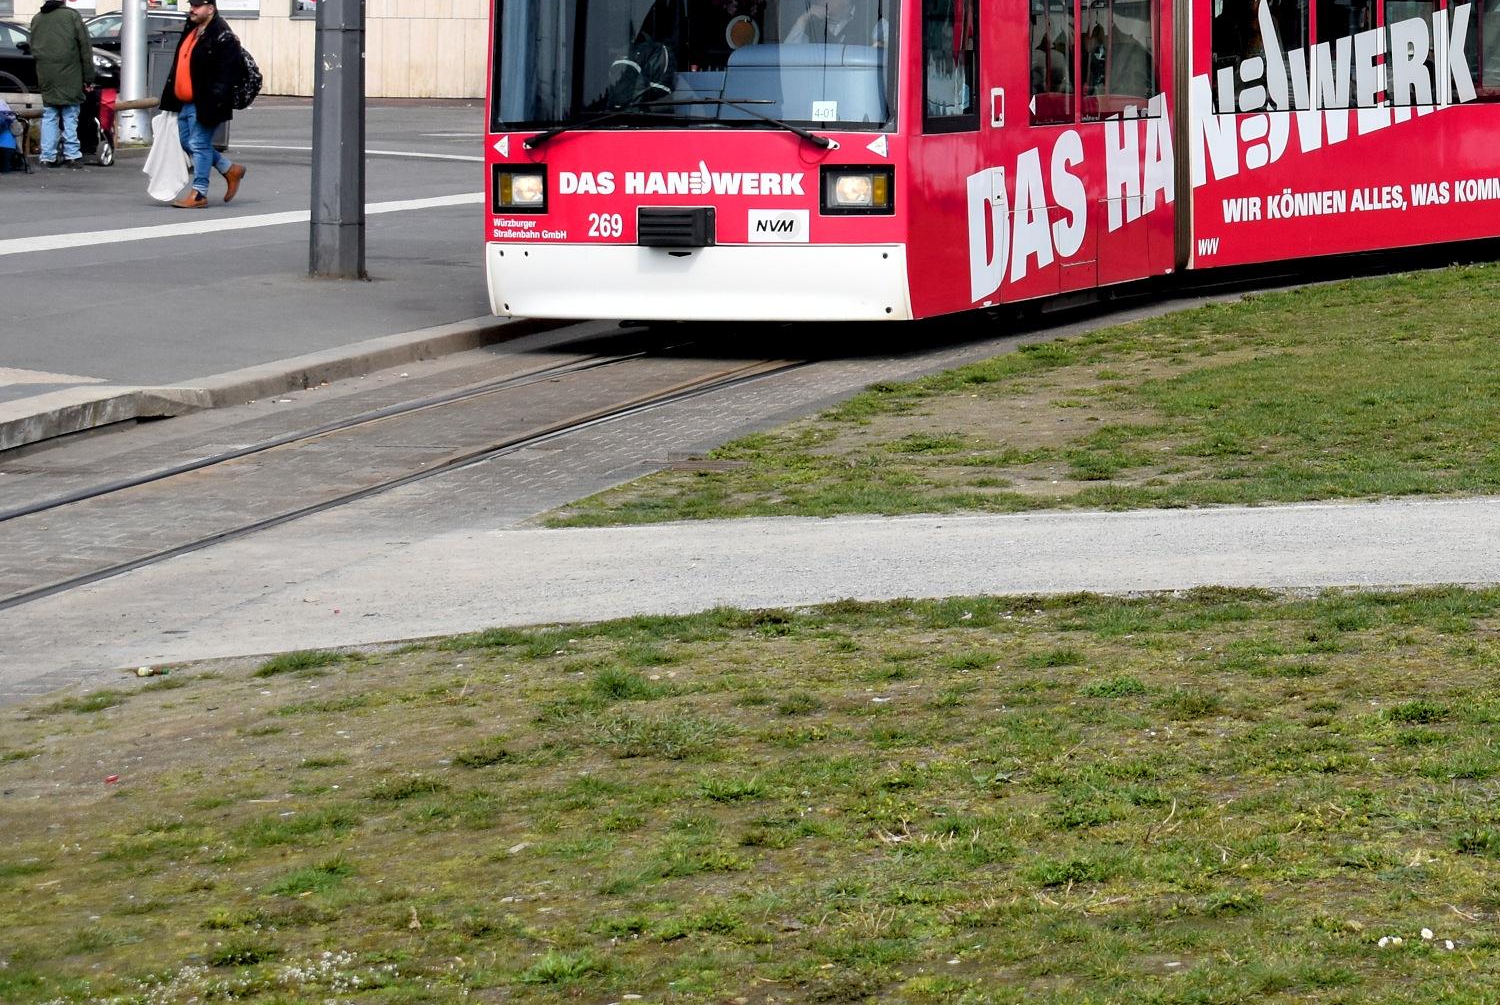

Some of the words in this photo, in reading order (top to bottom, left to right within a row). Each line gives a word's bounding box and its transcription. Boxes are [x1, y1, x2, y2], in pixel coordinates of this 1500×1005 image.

[559, 171, 615, 194] DAS
[624, 160, 805, 196] HANDWERK
[1222, 199, 1261, 223] WIR
[1267, 189, 1346, 219] KÖNNEN
[1350, 185, 1407, 212] ALLES,
[1411, 181, 1450, 205] WAS
[494, 218, 536, 229] Würzburger
[588, 213, 623, 238] 269
[756, 220, 794, 232] NVM
[966, 129, 1087, 304] DAS
[494, 229, 540, 239] Straßenbahn
[542, 230, 567, 239] GmbH
[1198, 237, 1219, 257] WVV
